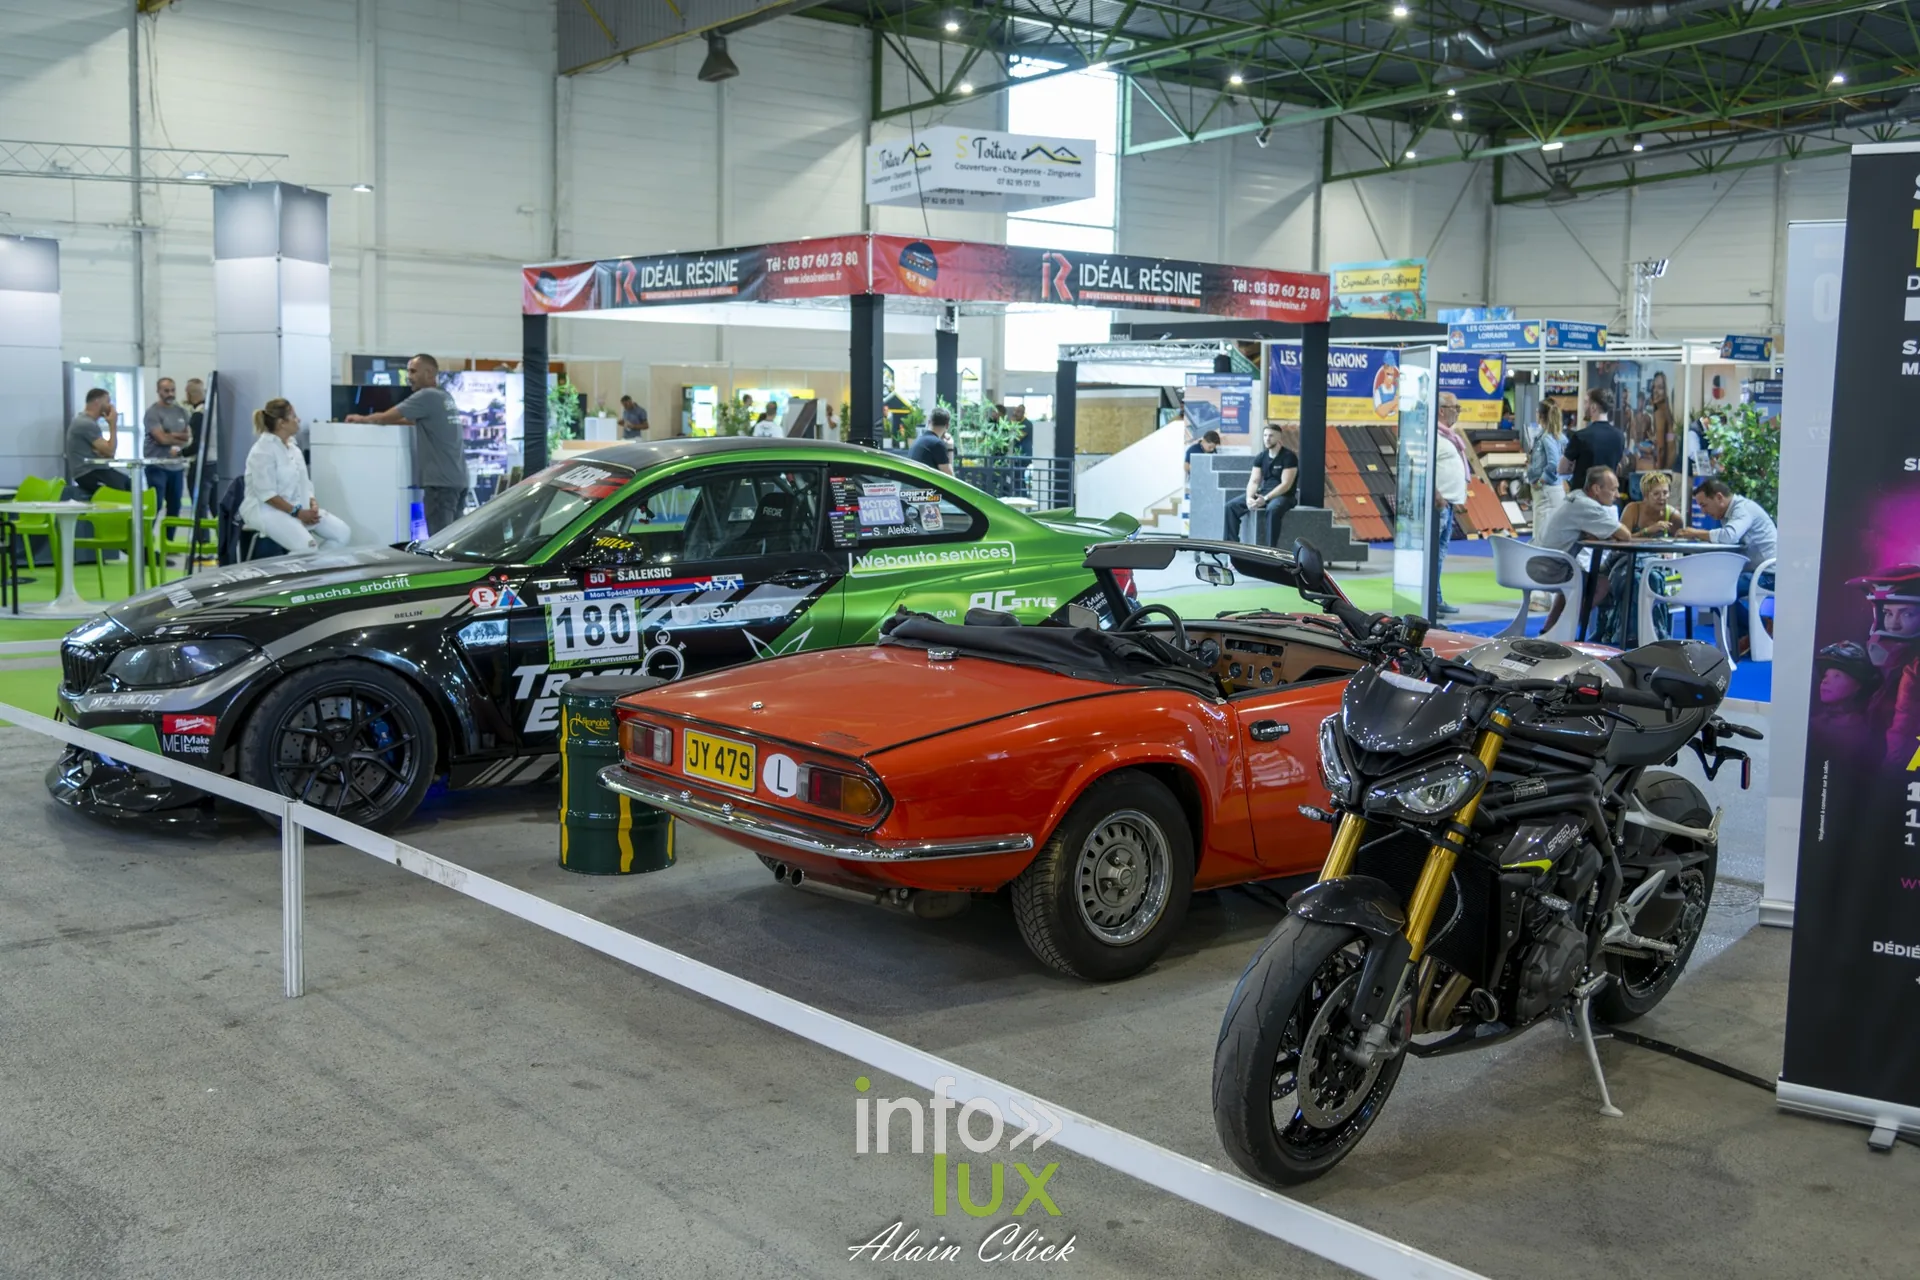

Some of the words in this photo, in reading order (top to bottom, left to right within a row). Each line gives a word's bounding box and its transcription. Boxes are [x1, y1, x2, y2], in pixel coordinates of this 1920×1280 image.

[972, 136, 1017, 161] Toiture
[955, 162, 997, 172] Couverture
[1003, 166, 1040, 176] Charpente
[1047, 170, 1082, 179] Zinguerie
[766, 257, 781, 272] Tél
[788, 256, 800, 270] 03
[802, 255, 814, 269] 87
[816, 253, 829, 267] 60
[831, 252, 844, 267] 23
[845, 251, 858, 265] 80
[641, 259, 683, 288] IDÉAL
[686, 256, 739, 285] RÉSINE
[1079, 259, 1134, 290] IDÉAL
[1139, 263, 1202, 295] RÉSINE
[1232, 279, 1248, 293] Tél
[1254, 281, 1267, 294] 03
[1268, 283, 1280, 296] 87
[1282, 285, 1296, 297] 60
[1297, 286, 1309, 299] 23
[1310, 287, 1321, 300] 80
[1478, 324, 1521, 332] COMPAGNONS
[1478, 332, 1508, 340] LORRAINS
[1280, 350, 1297, 366] LES
[860, 501, 897, 509] MOTOR
[862, 508, 901, 521] MILK
[873, 527, 883, 536] S.
[856, 550, 937, 569] Webauto
[940, 546, 1010, 563] services
[306, 577, 411, 602] sacha_srbdrift
[606, 589, 639, 598] Spécialiste
[641, 587, 660, 595] Auto
[1011, 597, 1058, 608] STYLE
[1086, 591, 1105, 607] Make
[556, 603, 631, 649] 180
[1439, 719, 1457, 736] RS
[184, 735, 210, 745] Make
[184, 745, 209, 754] Events
[689, 739, 710, 770] JY
[715, 746, 750, 781] 479
[776, 759, 789, 792] L
[1820, 788, 1828, 810] consulter
